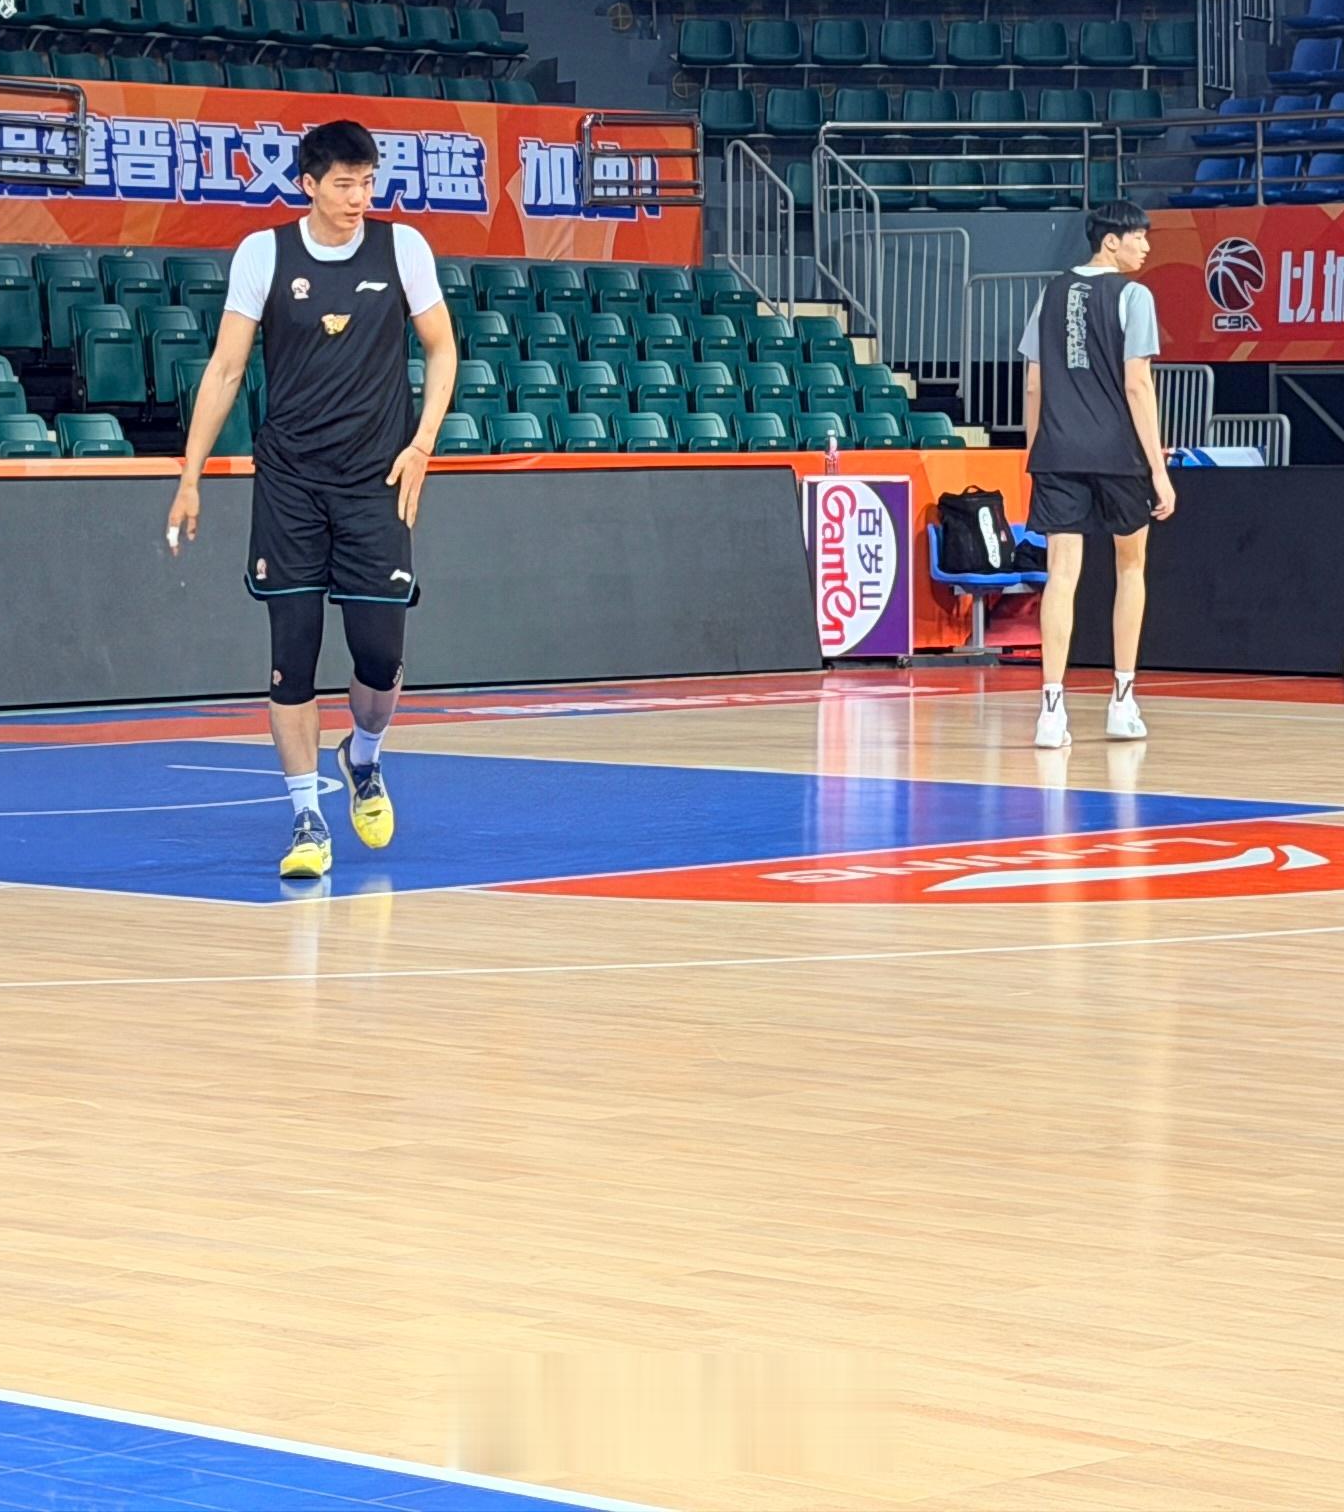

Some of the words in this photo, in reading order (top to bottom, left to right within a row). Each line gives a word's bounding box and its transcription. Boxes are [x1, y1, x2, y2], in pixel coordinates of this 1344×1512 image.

[1213, 313, 1263, 332] CBA
[856, 506, 884, 611] 百岁山
